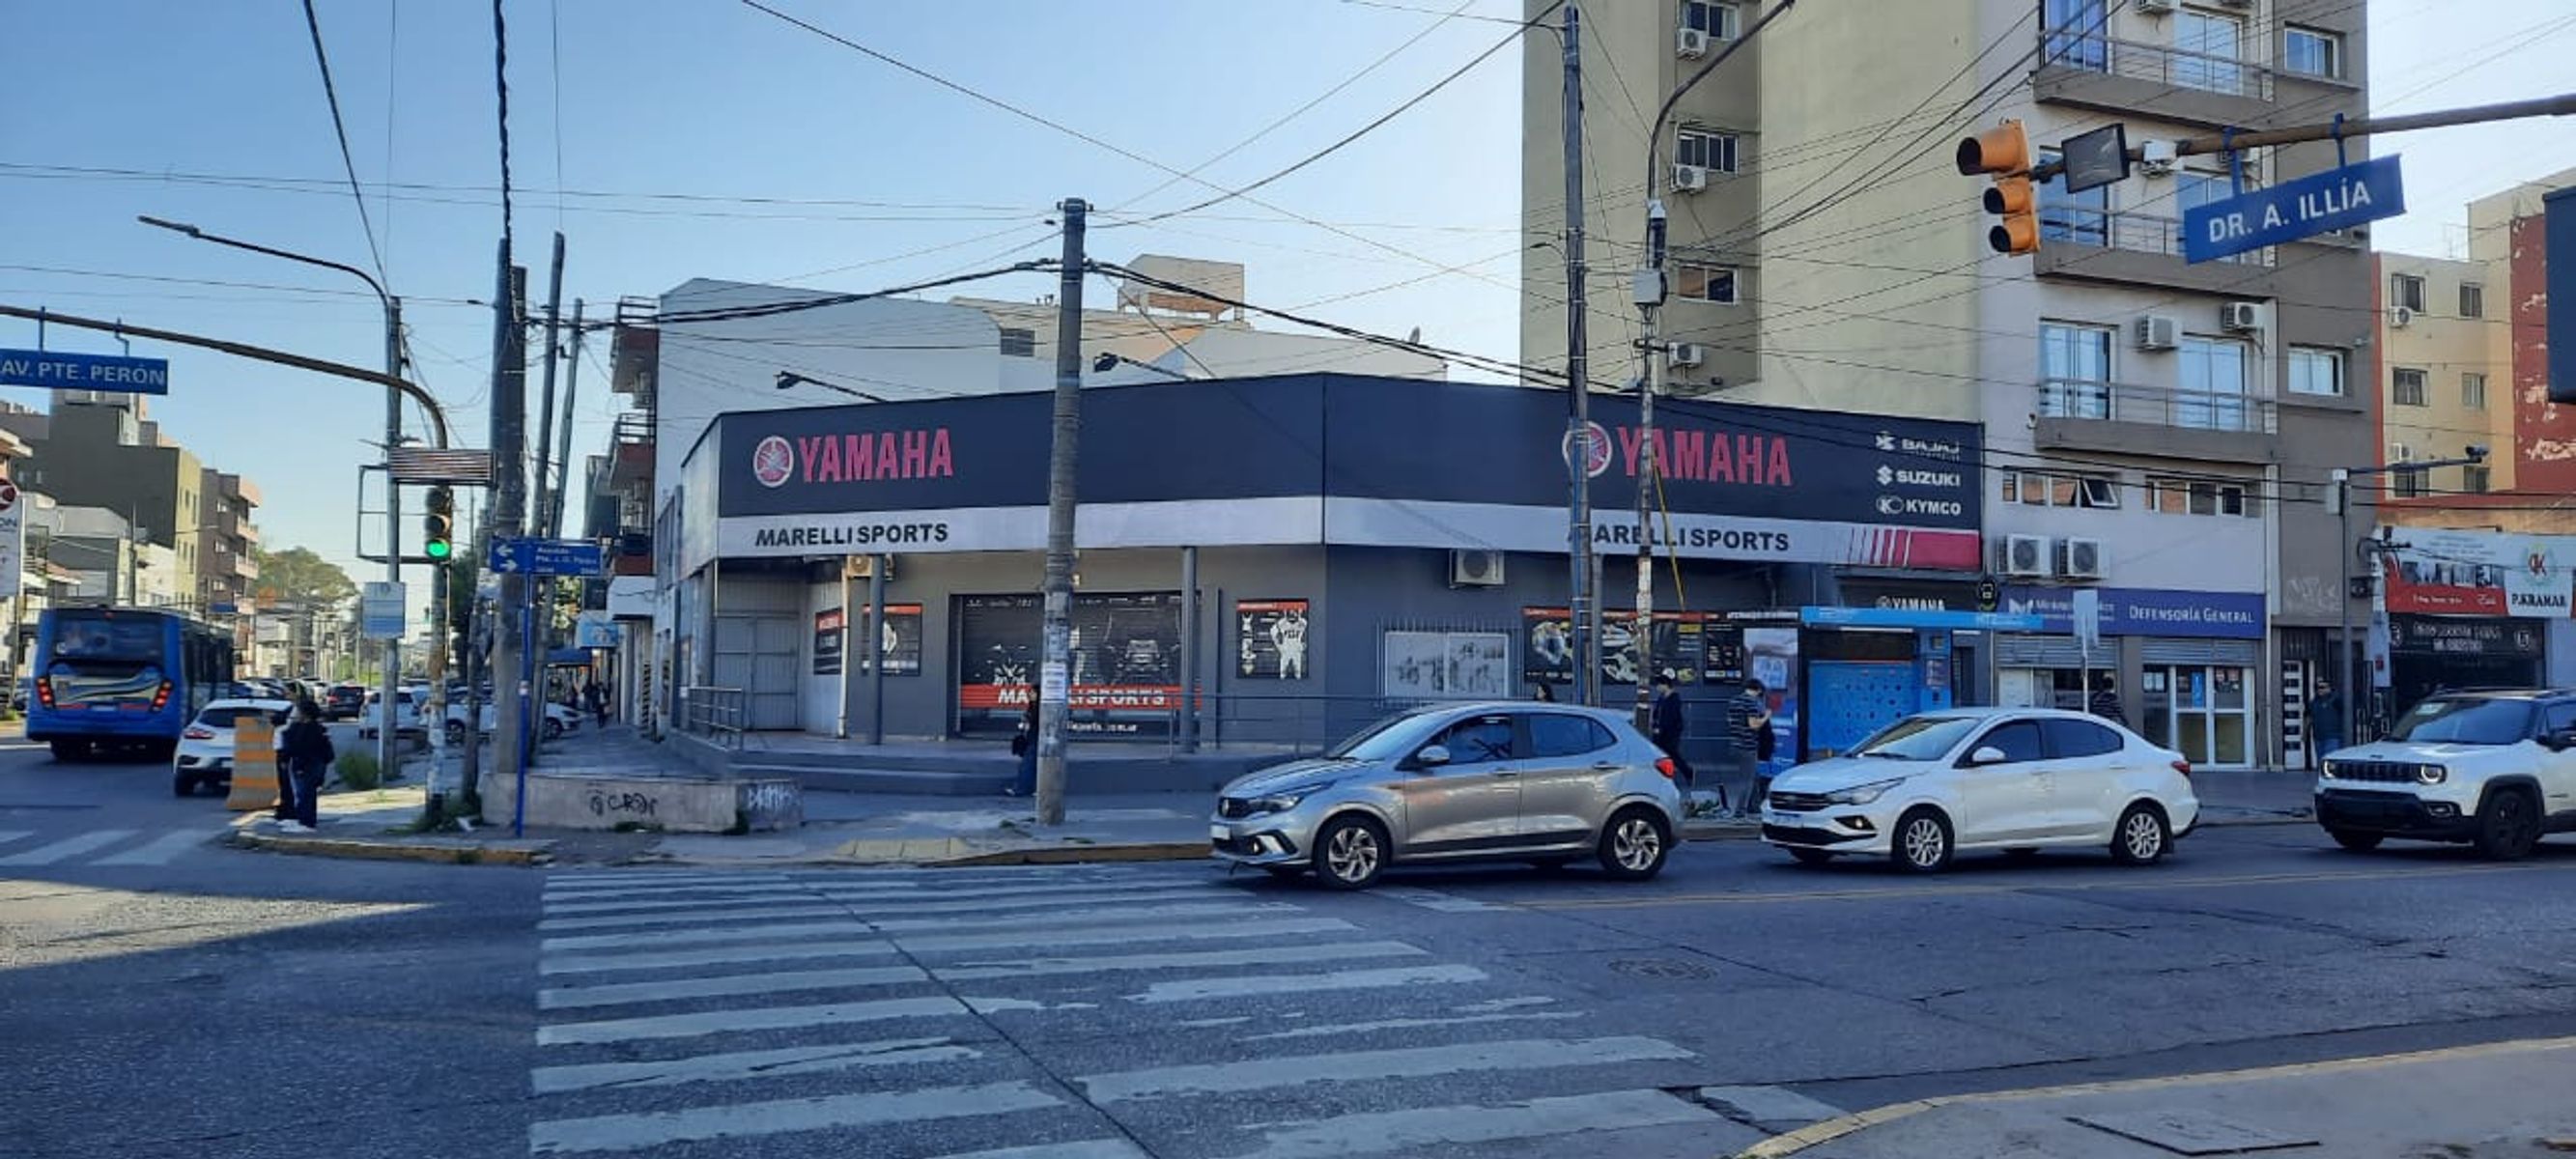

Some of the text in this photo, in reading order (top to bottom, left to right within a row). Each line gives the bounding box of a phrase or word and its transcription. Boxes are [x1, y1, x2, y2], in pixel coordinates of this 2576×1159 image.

[2208, 178, 2372, 243] DR. A. ILLÍA
[1, 359, 165, 385] AV. PTE. PERÓN
[799, 428, 954, 483] YAMAHA
[1617, 426, 1794, 487] YAMAHA
[1896, 470, 1961, 486] SUZUKI
[1906, 499, 1962, 516] KYMCO
[1891, 597, 1946, 611] YAMAHA
[2203, 606, 2254, 623] GENERAL
